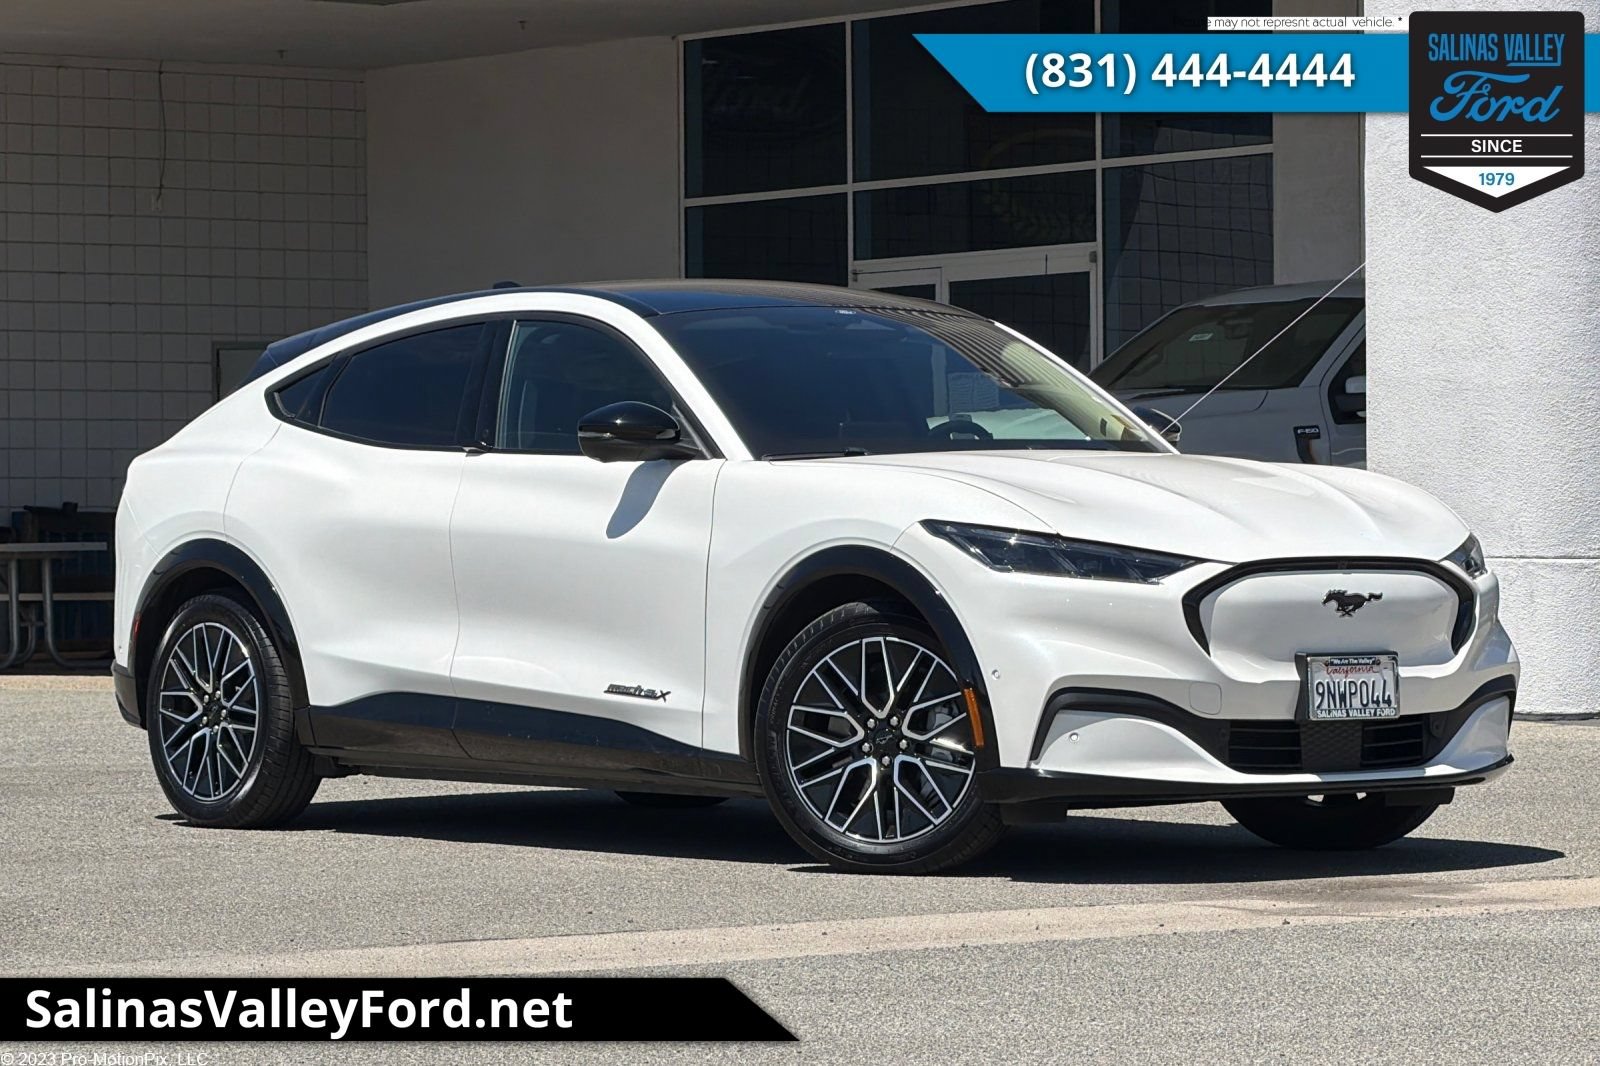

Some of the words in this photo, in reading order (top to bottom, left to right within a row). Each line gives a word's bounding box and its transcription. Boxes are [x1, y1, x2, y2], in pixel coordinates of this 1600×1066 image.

[1326, 666, 1376, 679] California
[1315, 679, 1393, 709] 9NWP044
[1316, 709, 1347, 718] SALINAS
[1348, 708, 1375, 718] VALLEY
[1376, 707, 1396, 717] FORD
